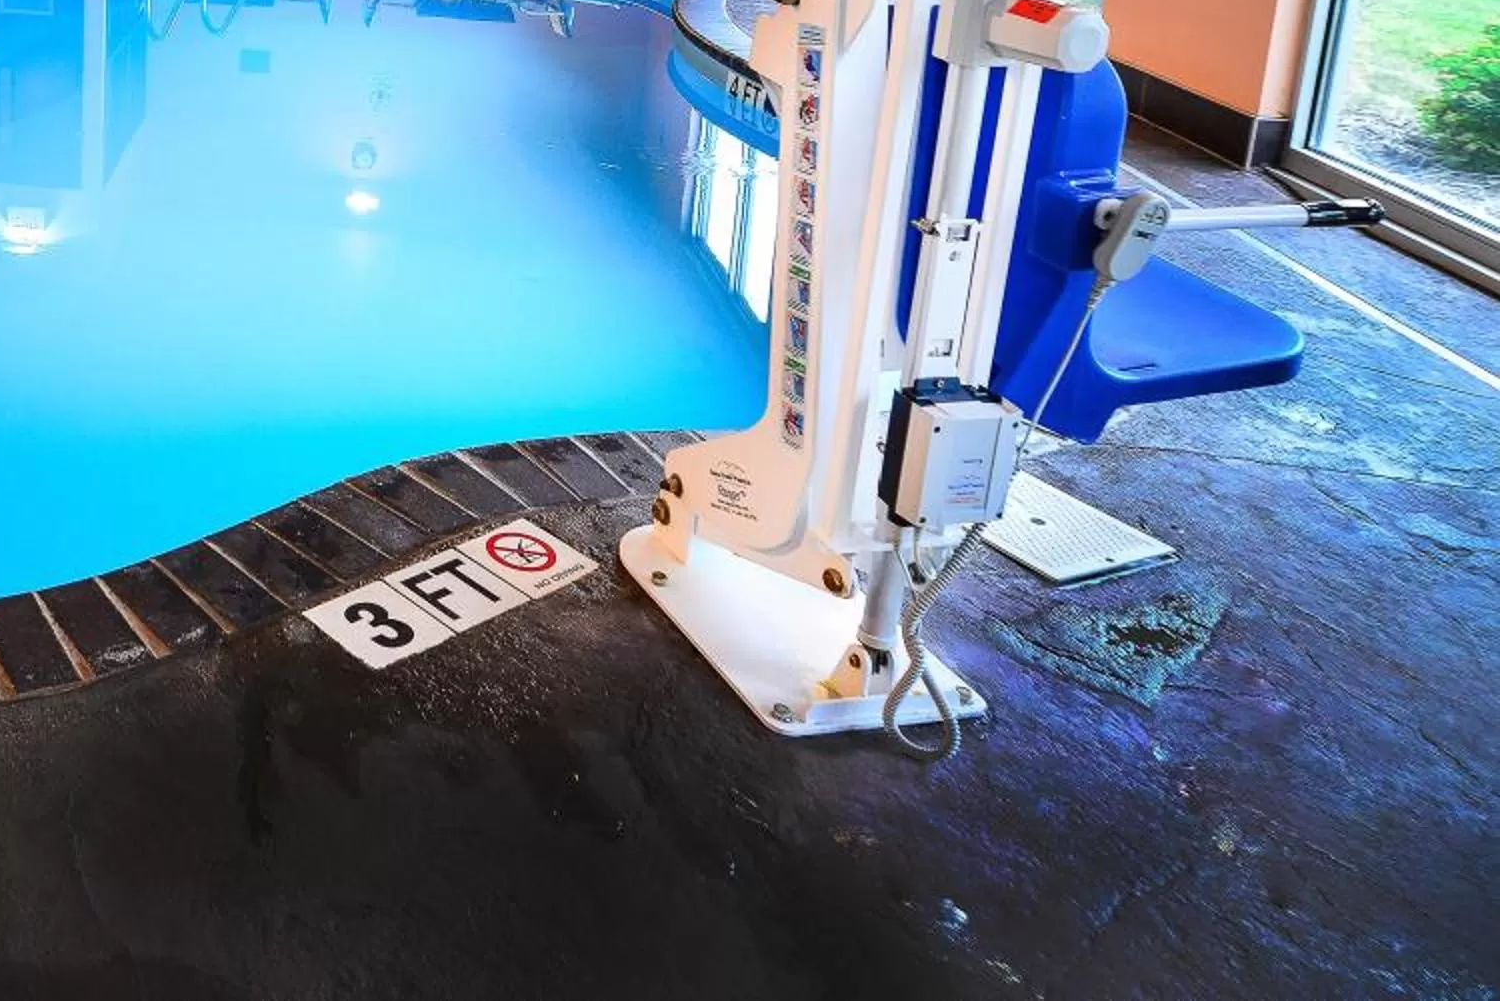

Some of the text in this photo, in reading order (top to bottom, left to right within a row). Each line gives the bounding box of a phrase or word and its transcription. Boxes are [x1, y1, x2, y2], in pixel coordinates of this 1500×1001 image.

[729, 76, 762, 108] 4 FT
[344, 558, 500, 648] 3 FT
